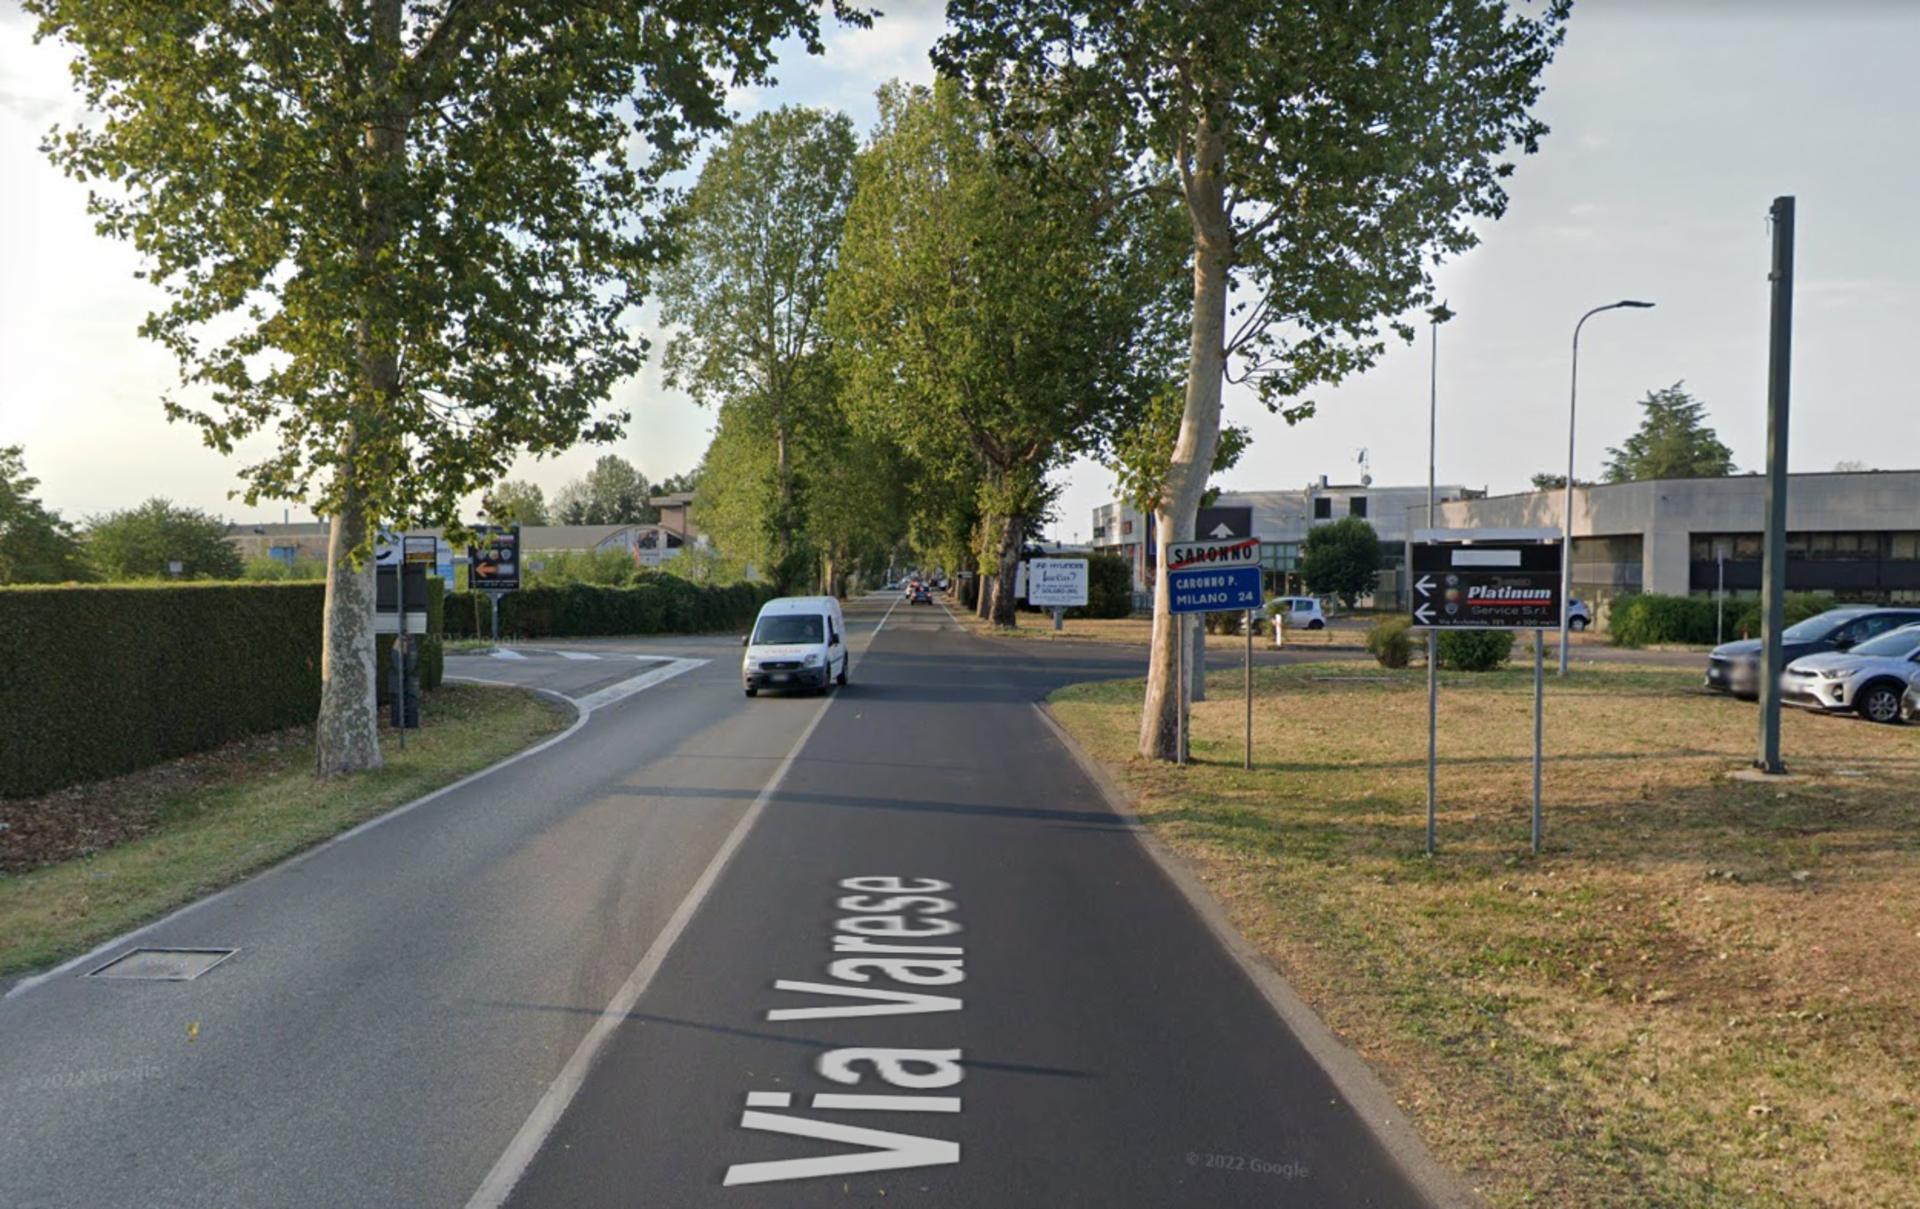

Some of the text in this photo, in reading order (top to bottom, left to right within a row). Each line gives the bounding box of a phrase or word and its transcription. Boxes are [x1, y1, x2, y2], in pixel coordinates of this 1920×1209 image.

[1175, 545, 1252, 564] SARONNO
[1176, 576, 1238, 590] CARONNO P.
[1176, 592, 1254, 605] MILANO 24
[1467, 585, 1552, 600] Platinum
[1471, 605, 1519, 616] Service
